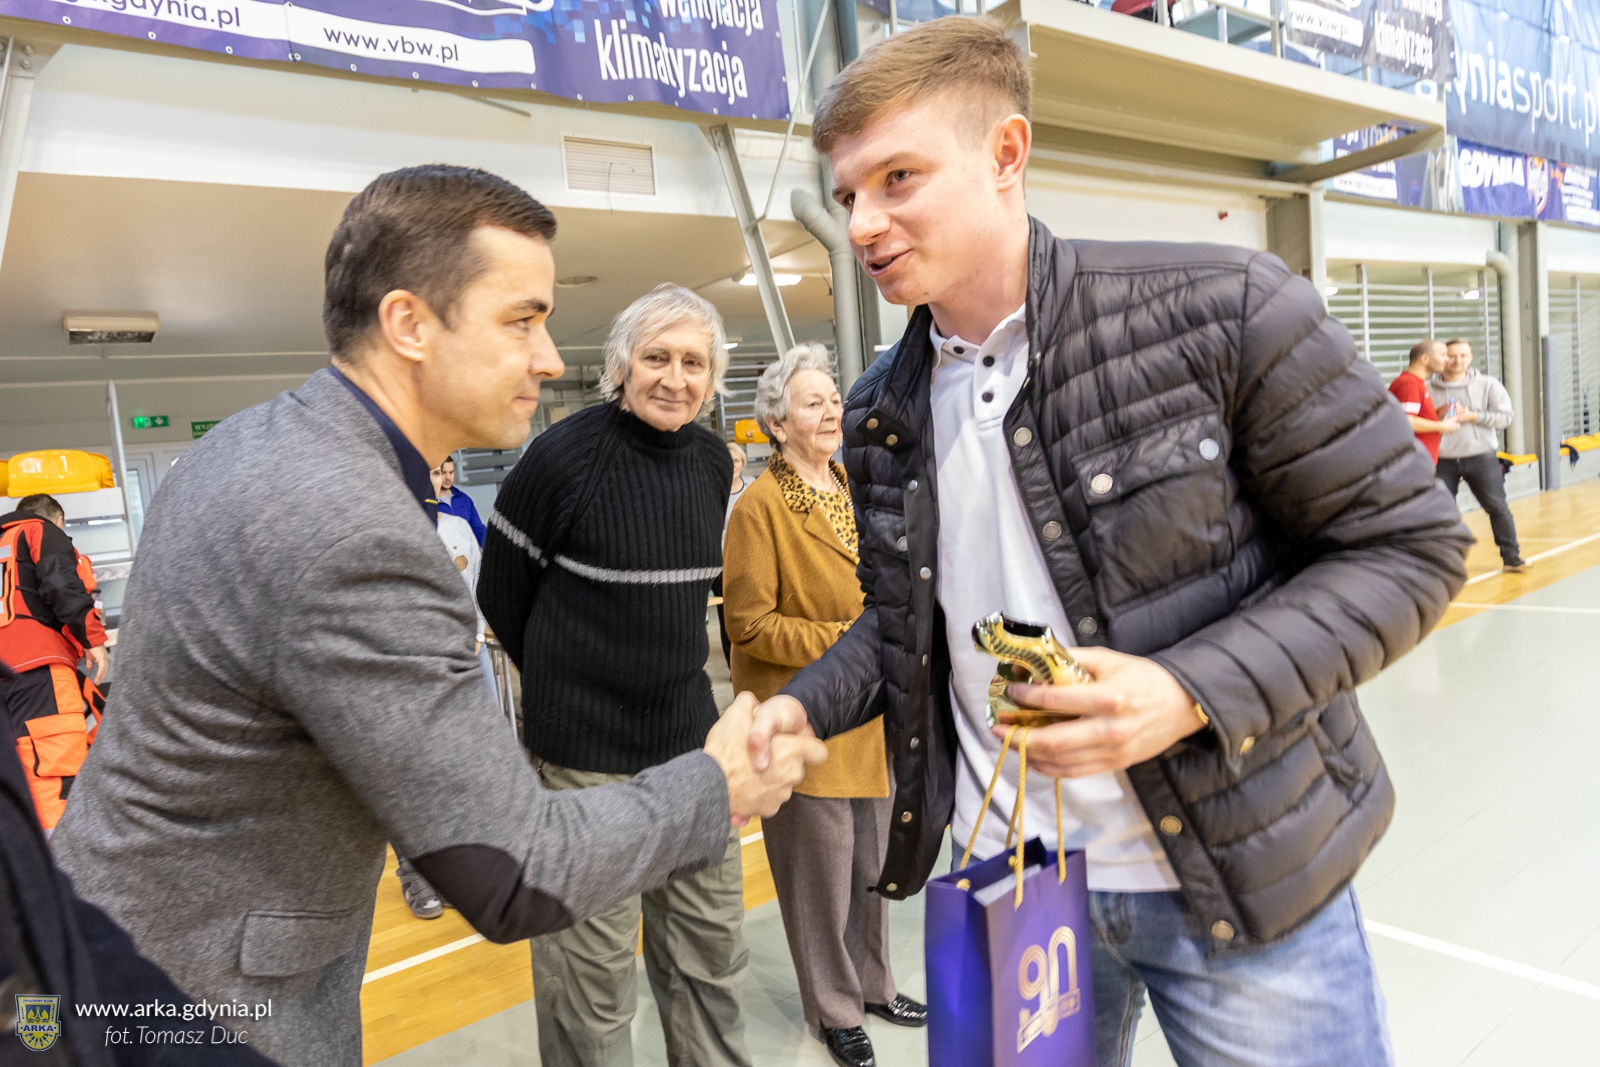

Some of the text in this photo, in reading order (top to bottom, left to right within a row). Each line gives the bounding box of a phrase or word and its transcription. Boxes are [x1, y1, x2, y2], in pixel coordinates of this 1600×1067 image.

[323, 27, 459, 63] www.vbw.pl
[594, 19, 748, 105] klimatyzacja
[1458, 148, 1525, 189] GDYNIA
